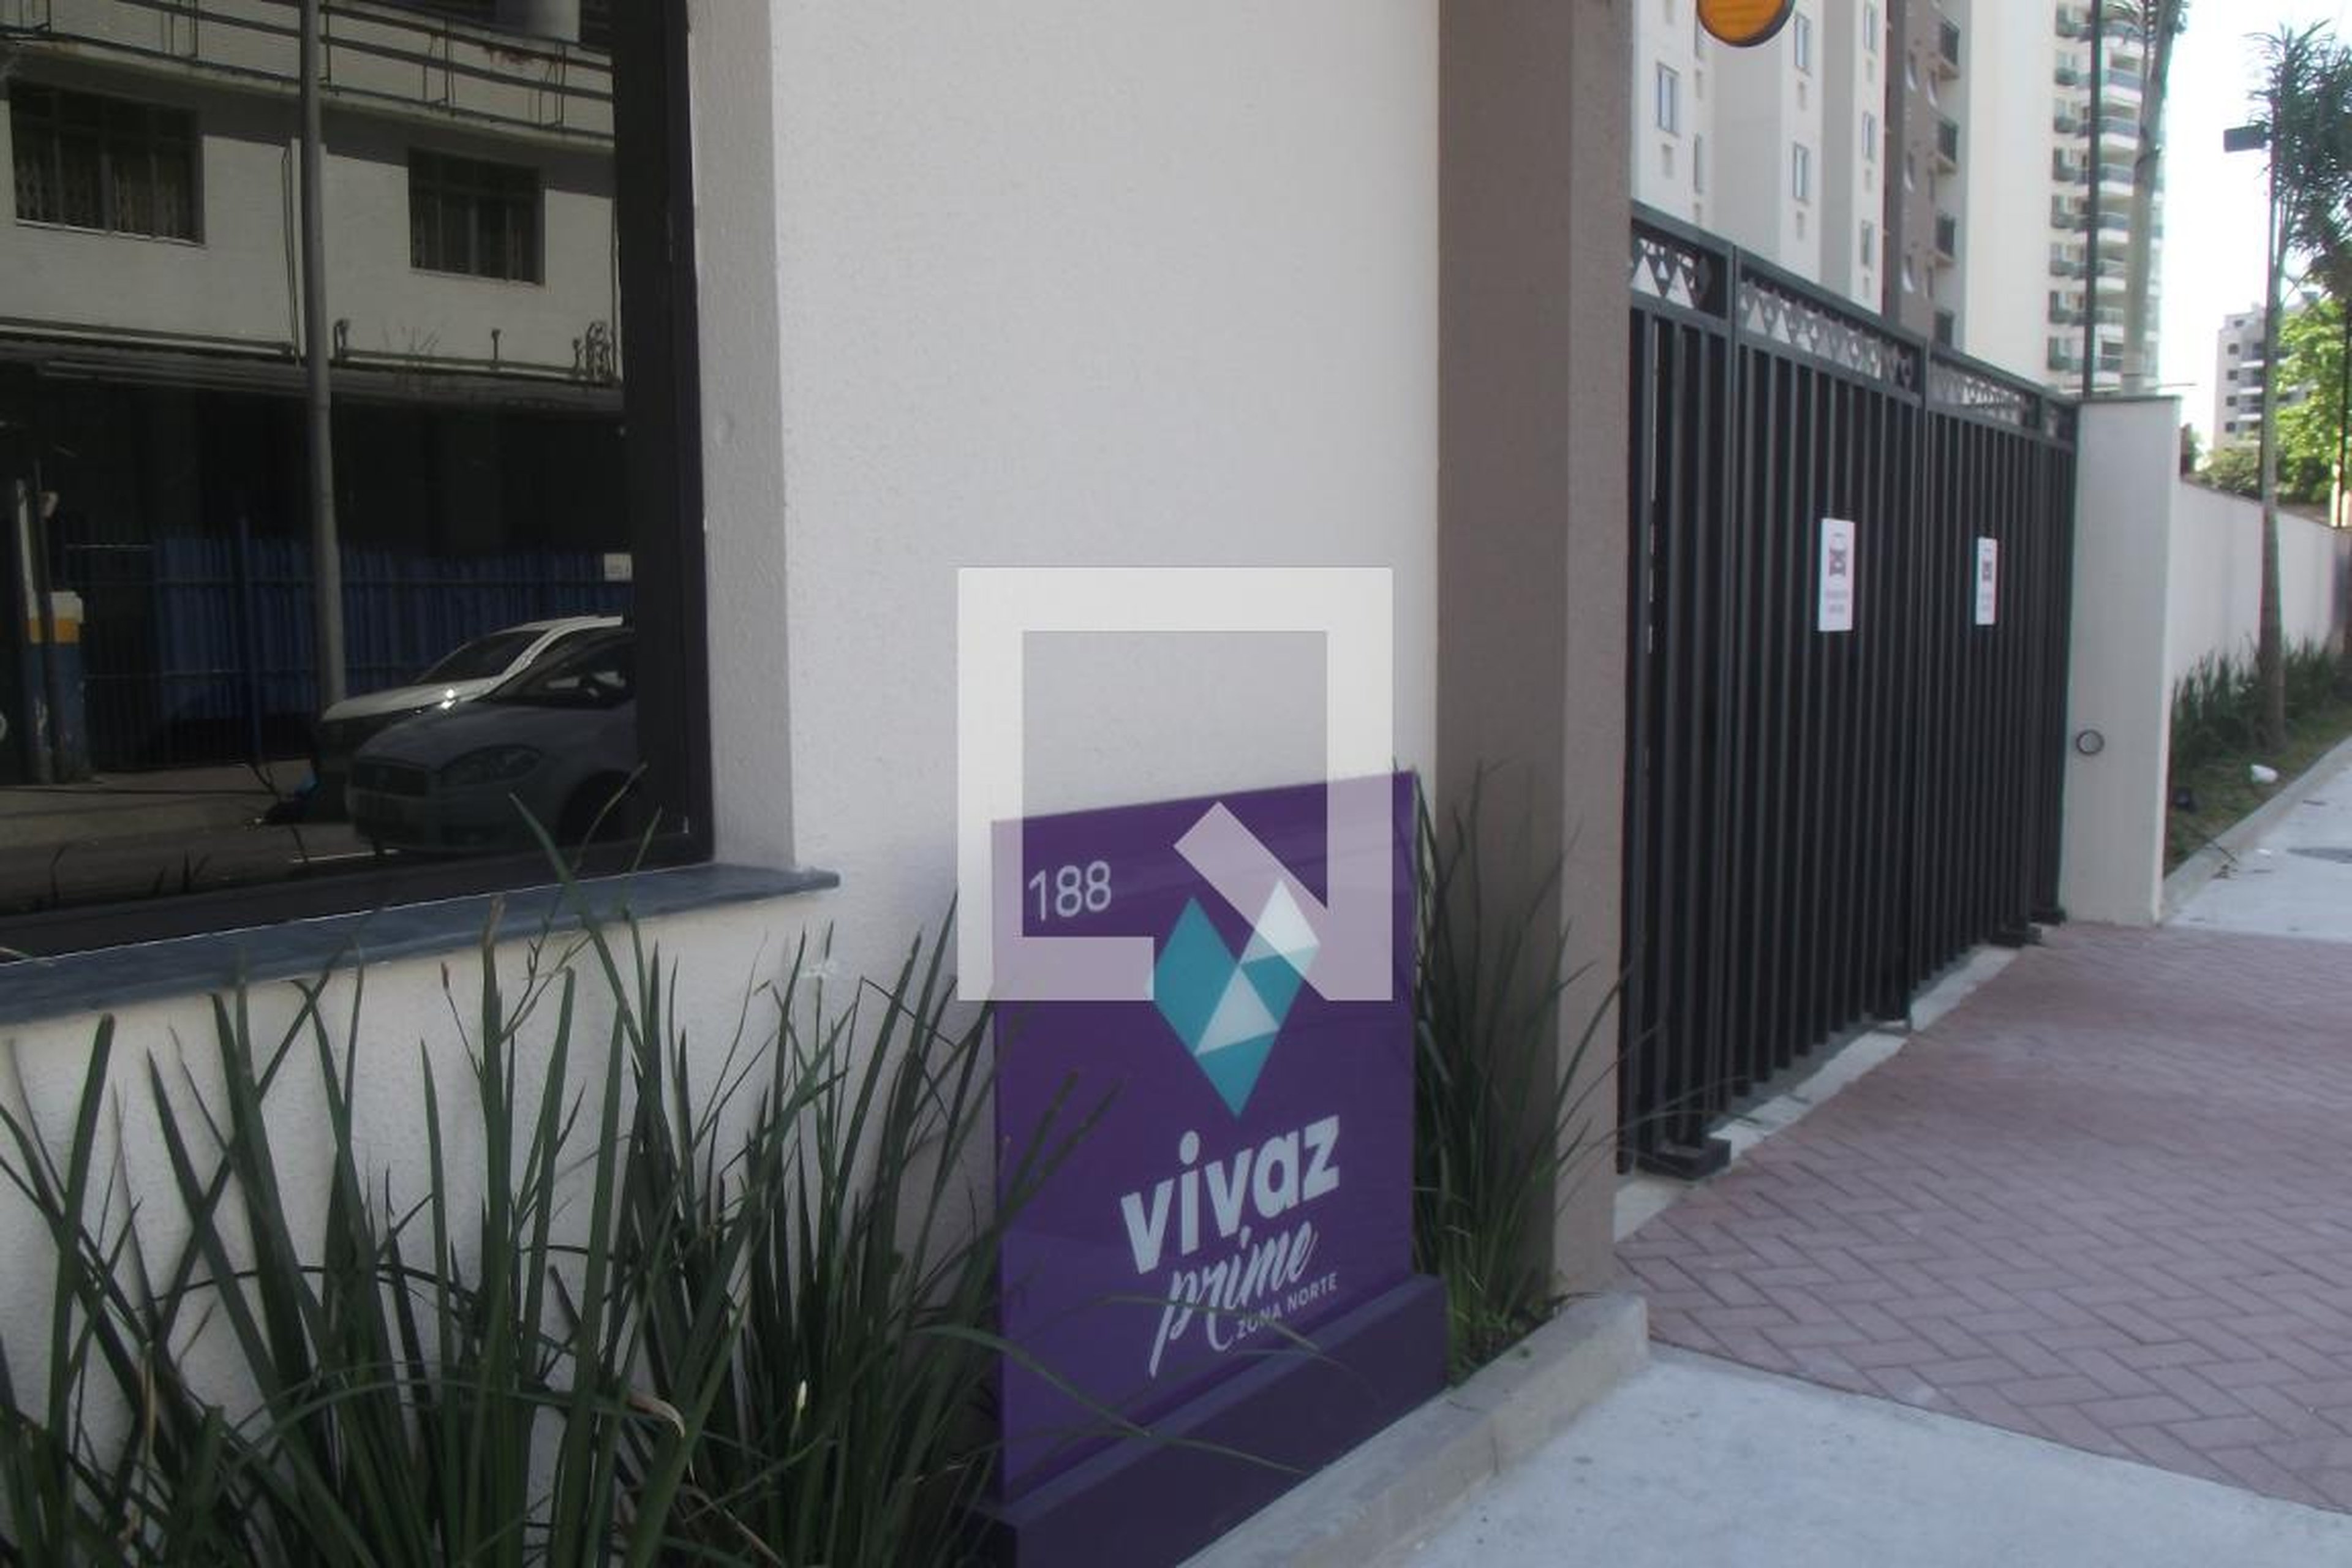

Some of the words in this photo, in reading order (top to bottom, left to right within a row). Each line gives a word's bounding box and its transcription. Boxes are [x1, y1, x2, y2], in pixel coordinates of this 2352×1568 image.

[1028, 860, 1112, 921] 188
[1120, 1115, 1340, 1275] vivaz
[1149, 1221, 1319, 1379] prime
[1287, 1271, 1338, 1313] NORTE
